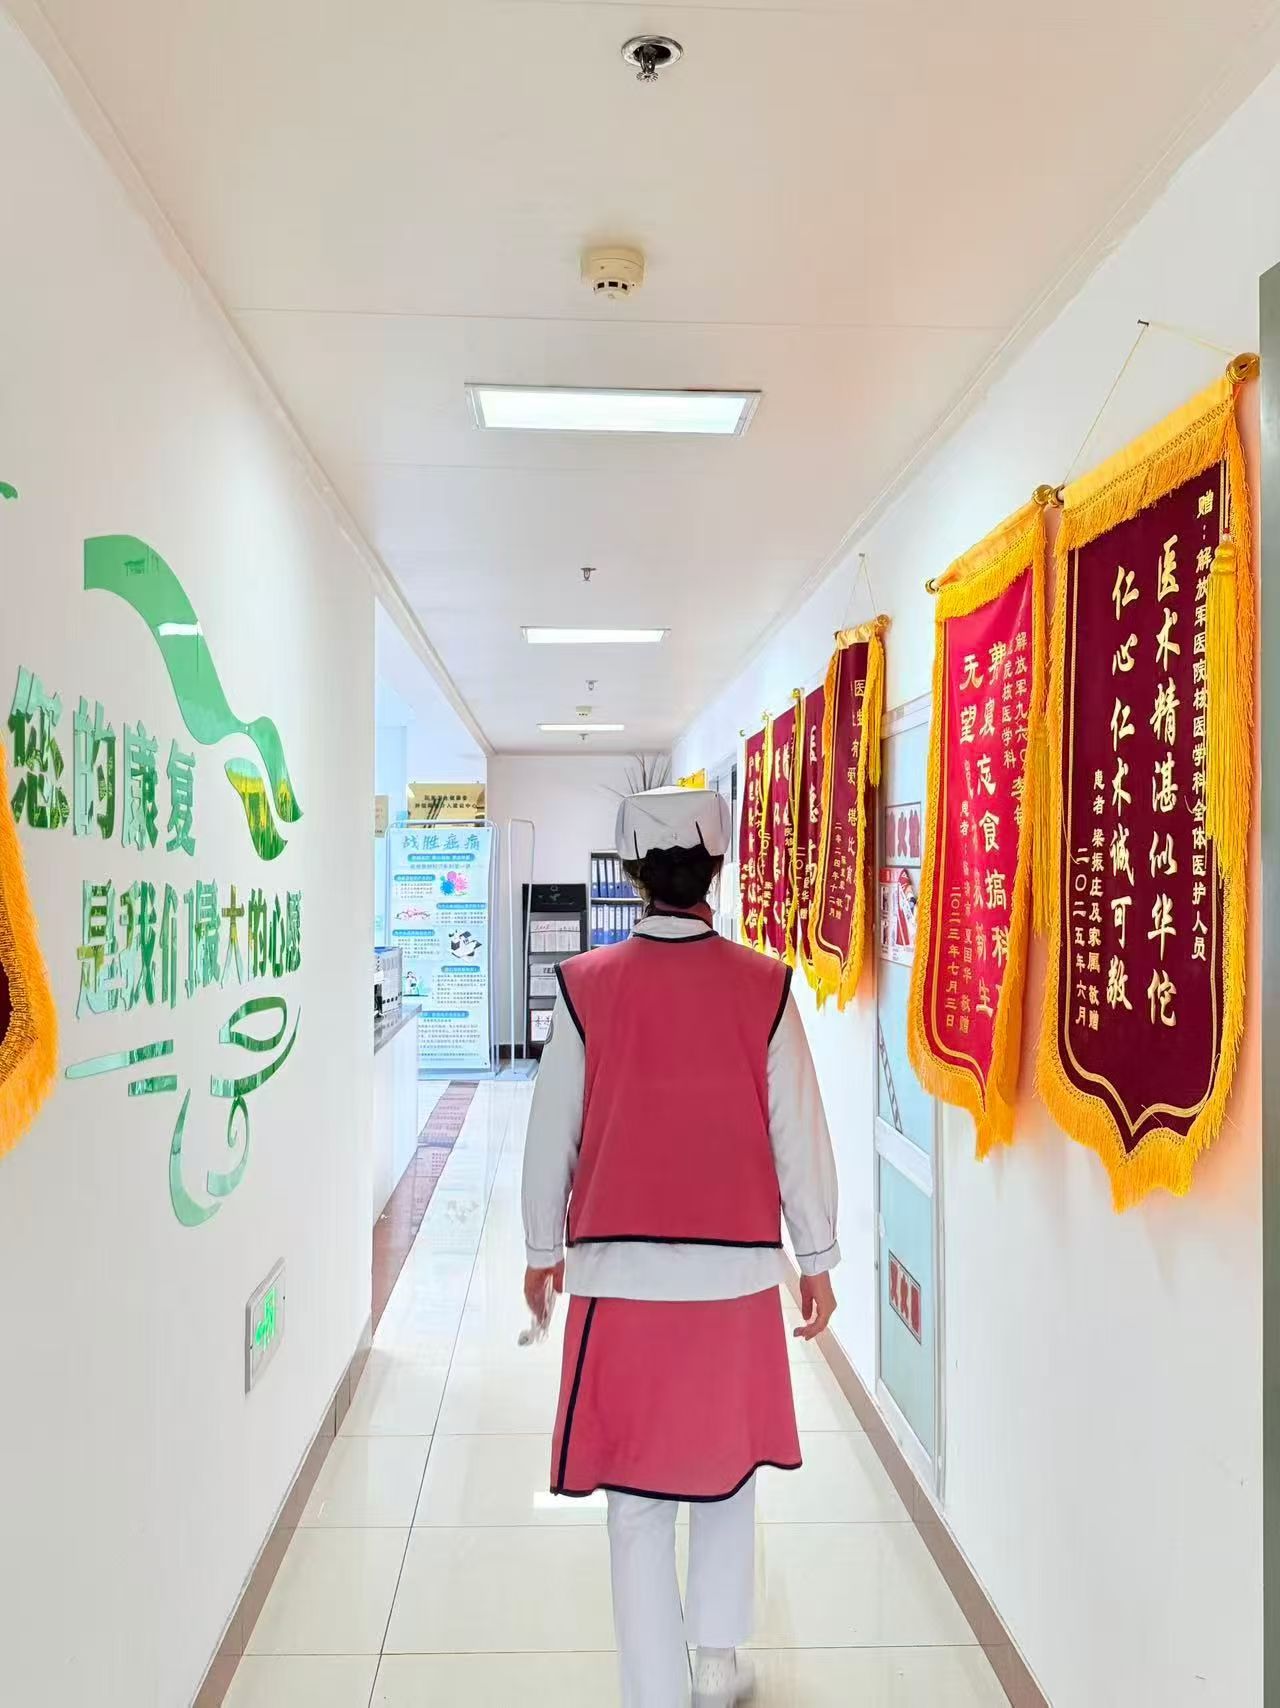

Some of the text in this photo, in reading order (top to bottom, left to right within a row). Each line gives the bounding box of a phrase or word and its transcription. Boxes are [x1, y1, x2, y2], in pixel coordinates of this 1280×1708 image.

[1106, 565, 1139, 1011] 仁心仁术诚可敬
[1147, 534, 1181, 1028] 医术精湛似华佗
